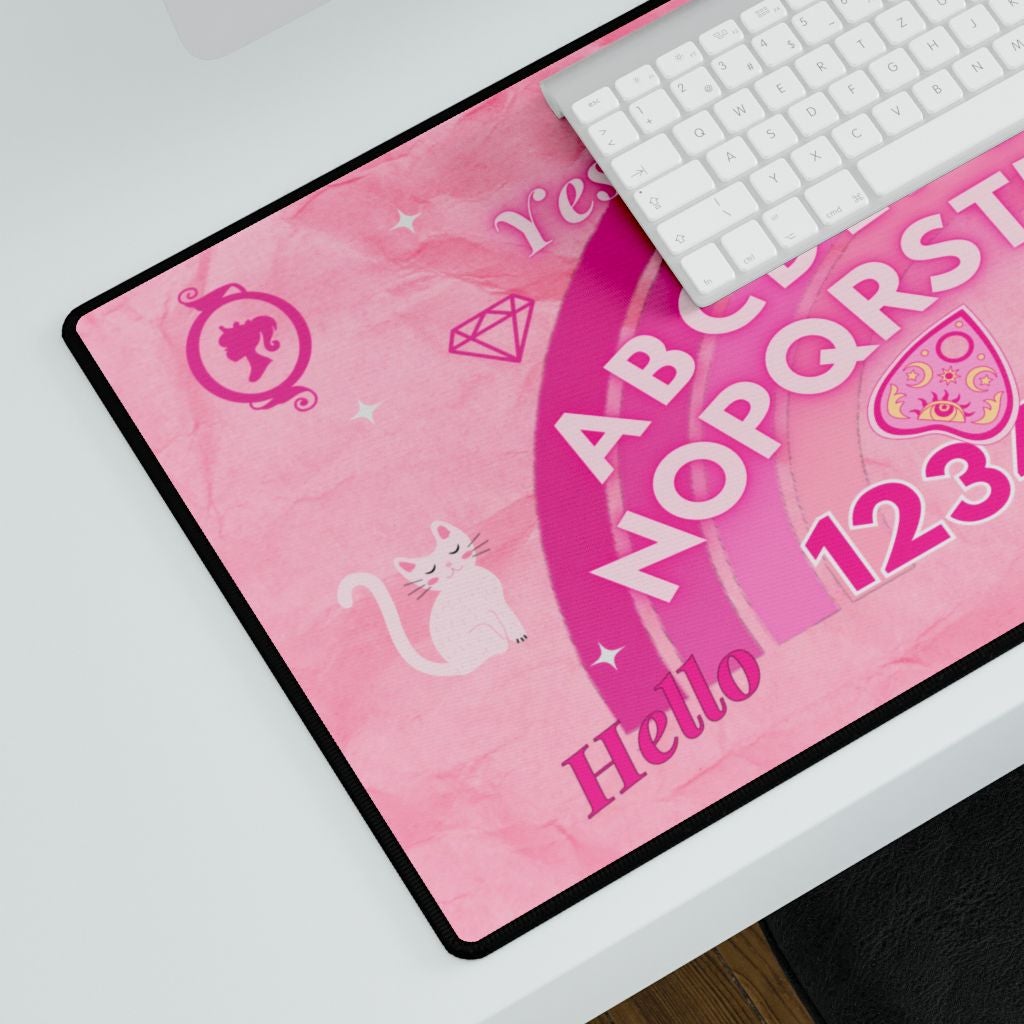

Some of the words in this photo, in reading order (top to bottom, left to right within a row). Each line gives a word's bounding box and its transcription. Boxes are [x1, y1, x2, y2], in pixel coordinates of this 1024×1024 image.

[677, 83, 687, 93] 2
[718, 61, 727, 71] 3
[760, 39, 768, 48] 4
[800, 17, 808, 27] 5
[693, 128, 706, 138] Q
[733, 104, 747, 117] W
[775, 83, 786, 94] E
[816, 61, 828, 72] R
[856, 39, 866, 49] T
[896, 17, 908, 29] Z
[726, 151, 737, 164] A
[765, 128, 777, 139] S
[805, 106, 818, 118] D
[847, 83, 857, 95] F
[887, 62, 899, 73] G
[926, 39, 939, 51] H
[970, 18, 978, 29] J
[768, 172, 779, 183] Y
[809, 150, 822, 162] X
[851, 128, 863, 139] C
[890, 105, 902, 116] V
[931, 84, 943, 95] B
[971, 61, 985, 73] N
[1011, 39, 1024, 51] M
[561, 649, 761, 820] Hello
